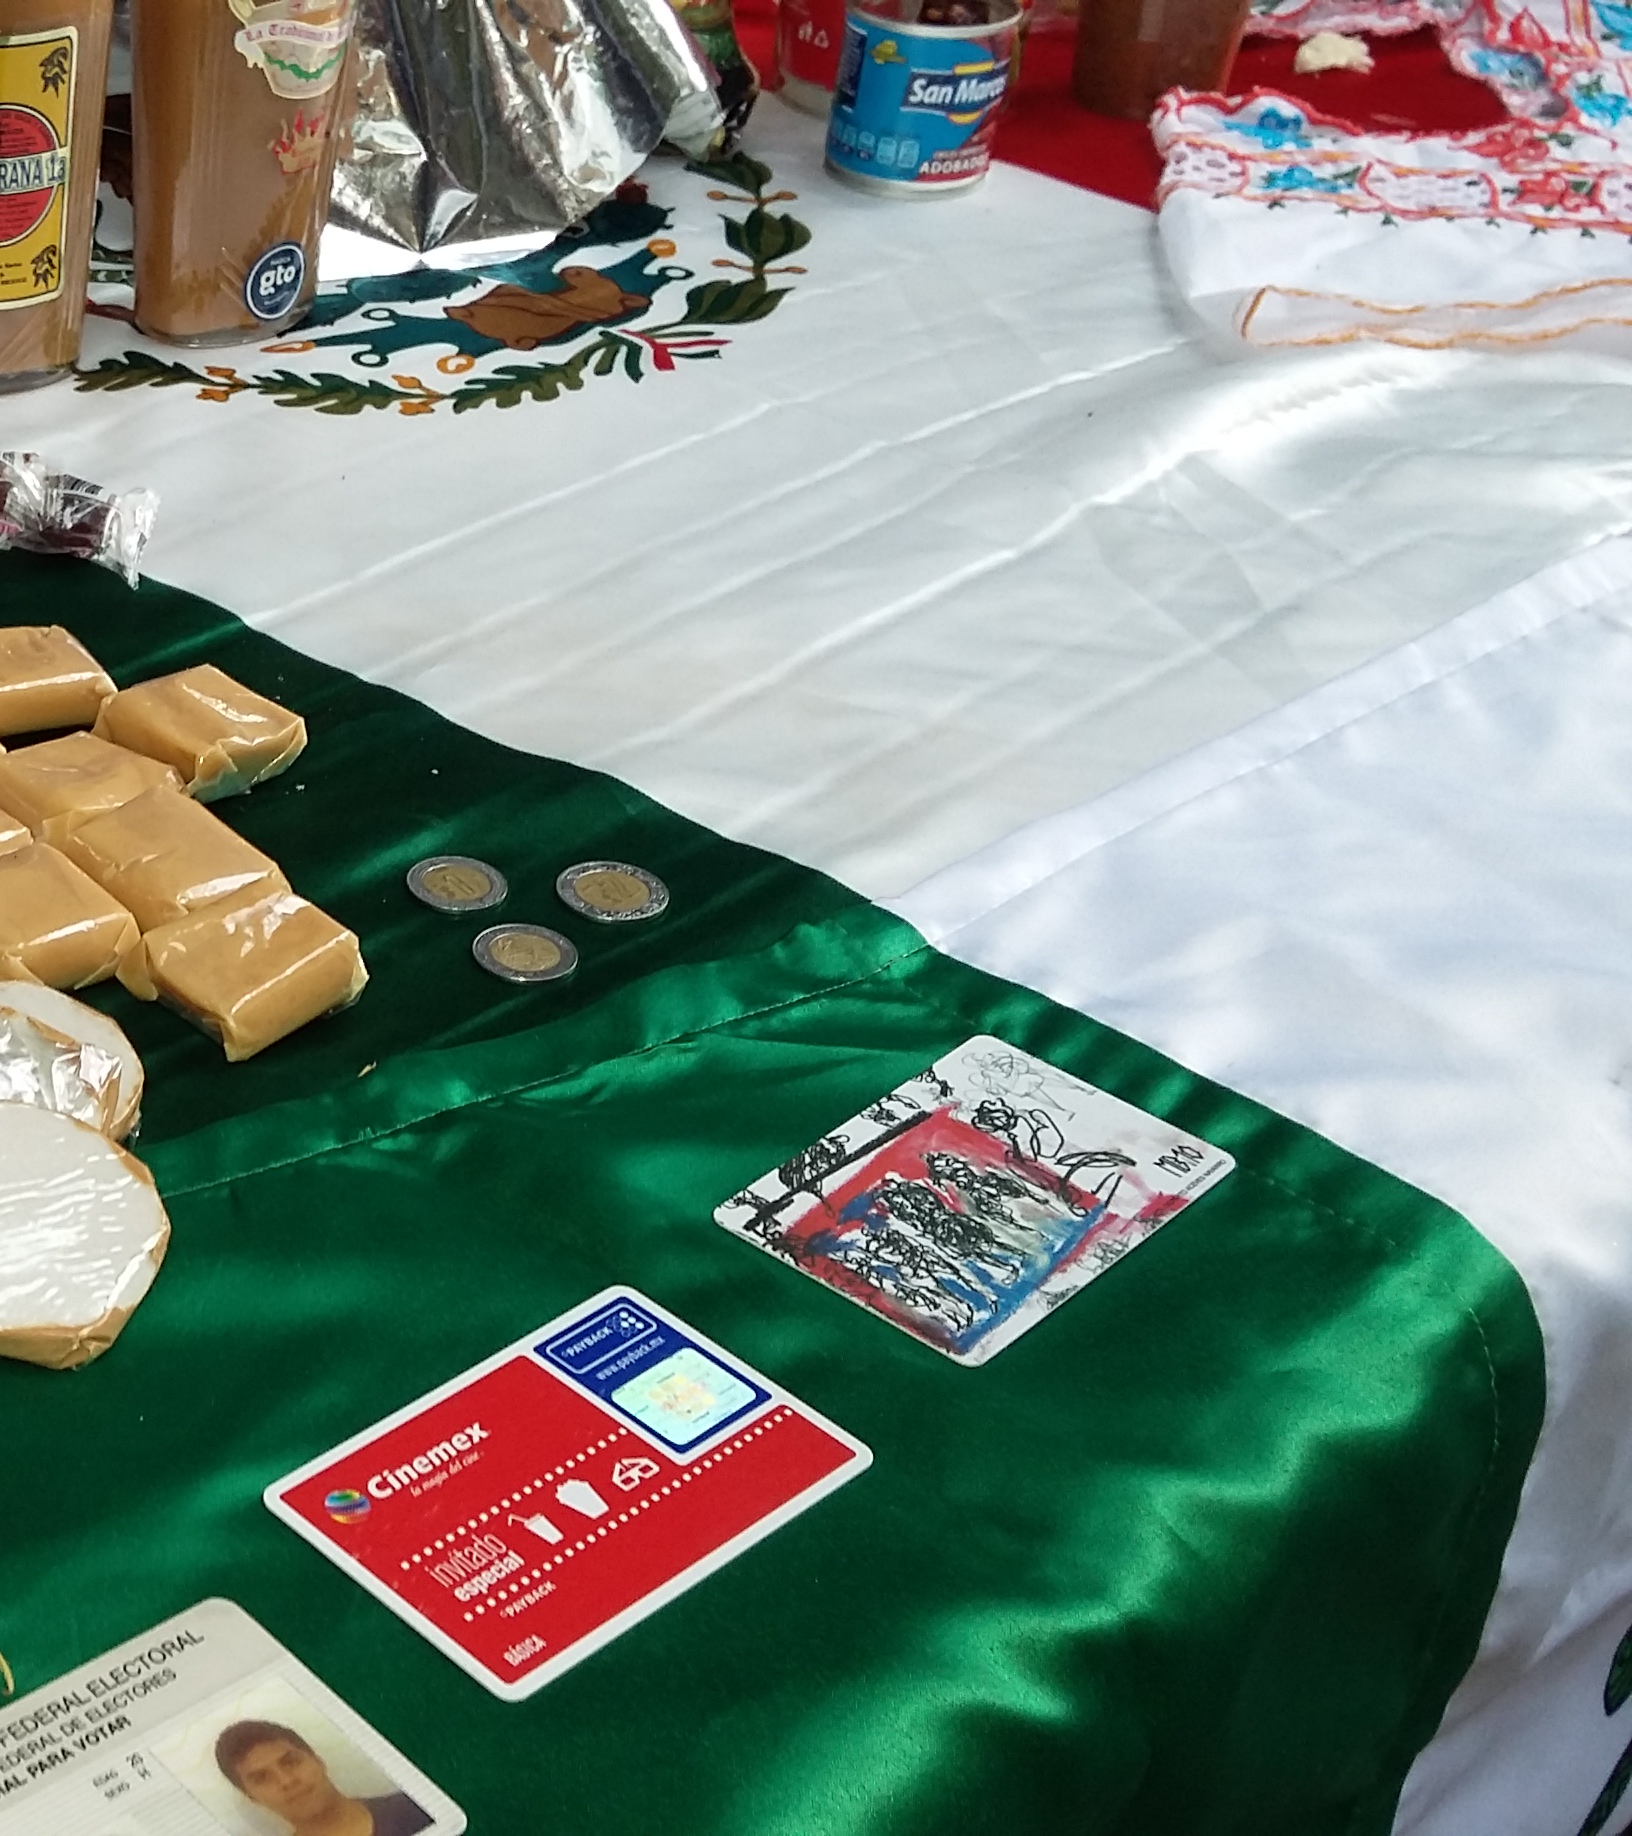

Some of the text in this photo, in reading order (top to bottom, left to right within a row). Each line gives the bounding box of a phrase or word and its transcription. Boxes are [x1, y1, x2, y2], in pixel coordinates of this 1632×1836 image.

[909, 78, 954, 104] San
[259, 265, 296, 296] gto
[567, 1325, 614, 1357] PAYBACK
[367, 1421, 490, 1500] Cinemex
[424, 1532, 507, 1588] invitado
[453, 1550, 525, 1602] especial
[504, 1580, 557, 1617] PAYBACK
[85, 1629, 206, 1699] ELECTORAL
[60, 1716, 87, 1738] DE
[84, 1666, 178, 1725] ELECTORES
[26, 1746, 76, 1780] PARA
[72, 1714, 133, 1752] VOTAR
